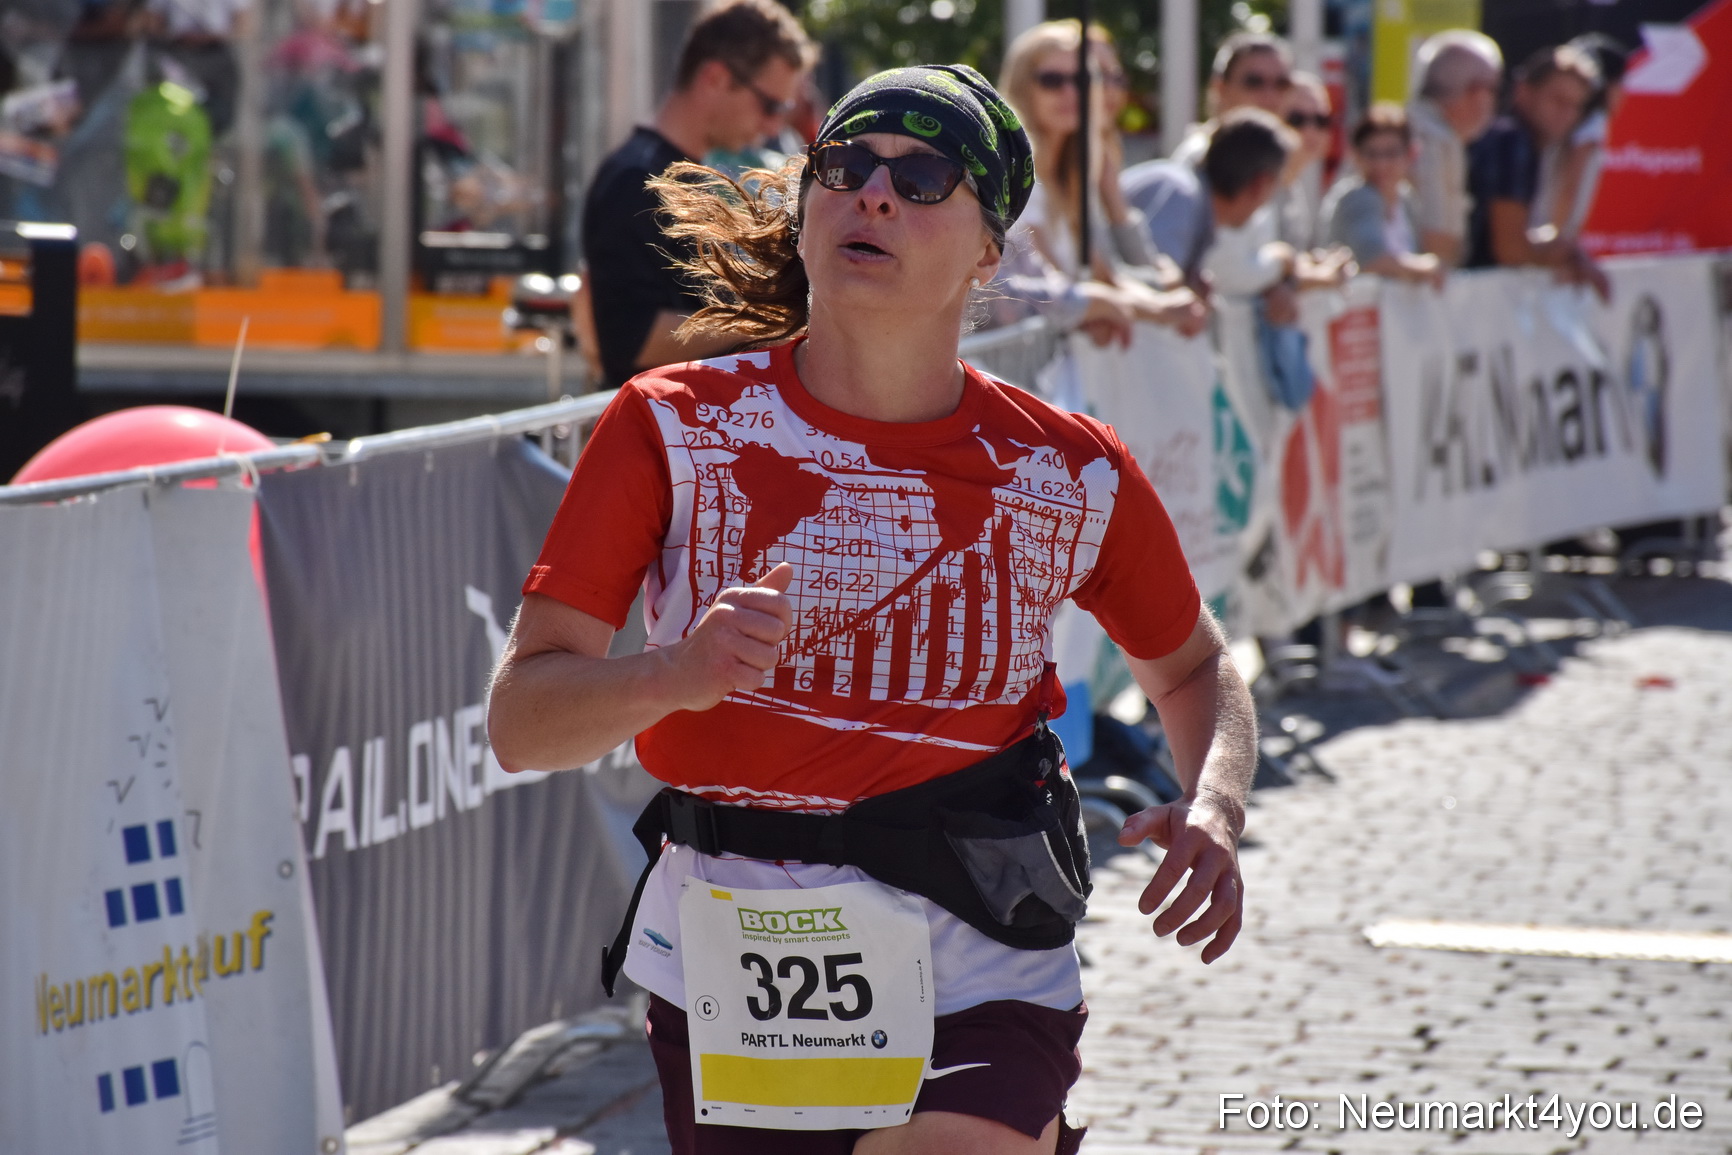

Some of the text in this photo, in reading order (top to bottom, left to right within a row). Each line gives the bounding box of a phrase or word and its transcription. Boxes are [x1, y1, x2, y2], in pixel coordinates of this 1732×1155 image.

[811, 535, 876, 558] 52.01
[807, 570, 875, 593] 26.22
[737, 907, 848, 934] BOCK
[742, 932, 851, 944] inspired by smart concepts
[740, 952, 873, 1021] 325
[741, 1032, 866, 1048] PARTL Neumarkt
